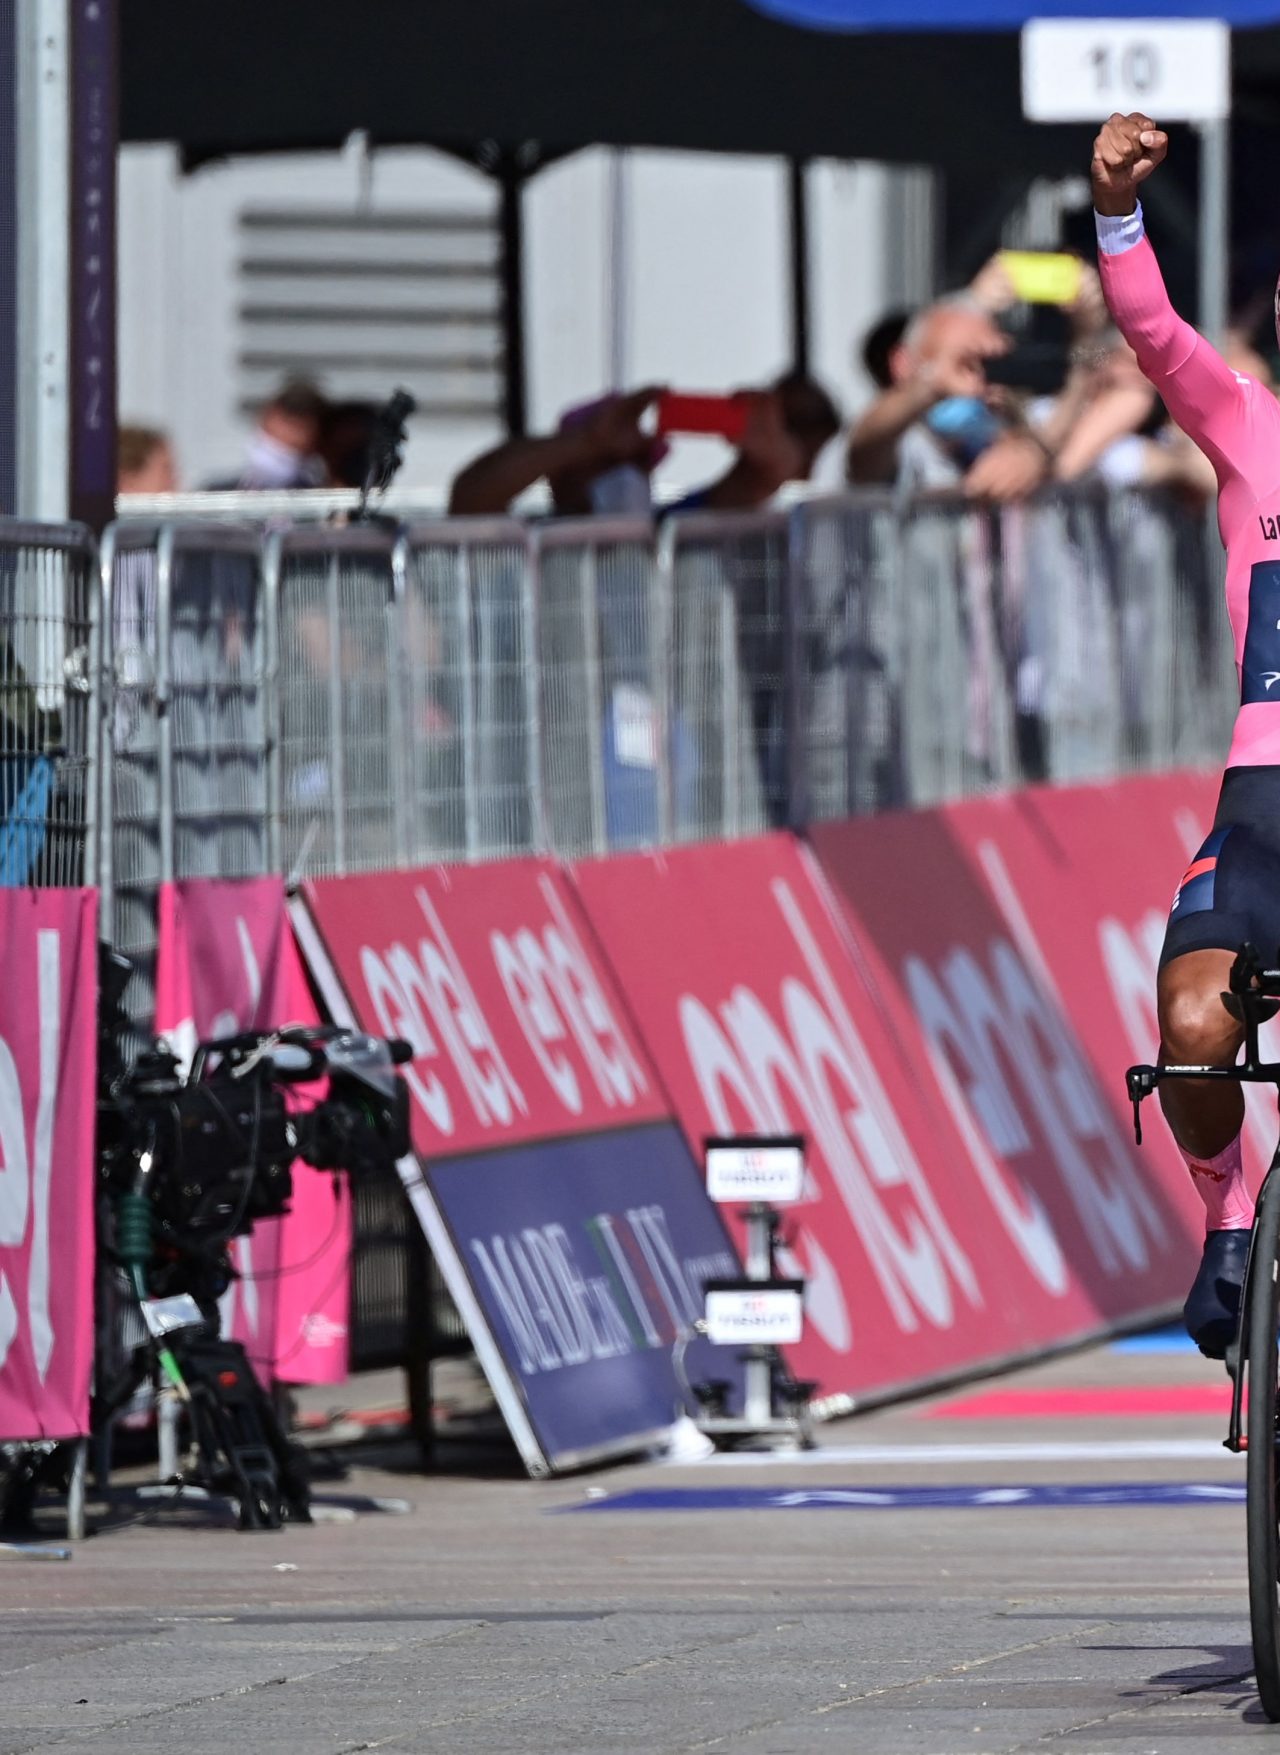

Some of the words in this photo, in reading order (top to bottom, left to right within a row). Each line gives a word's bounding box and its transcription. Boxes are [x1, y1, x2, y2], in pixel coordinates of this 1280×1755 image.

[1088, 43, 1161, 97] 10
[360, 885, 530, 1136] enel
[490, 870, 650, 1115] enel
[677, 876, 983, 1353] enel
